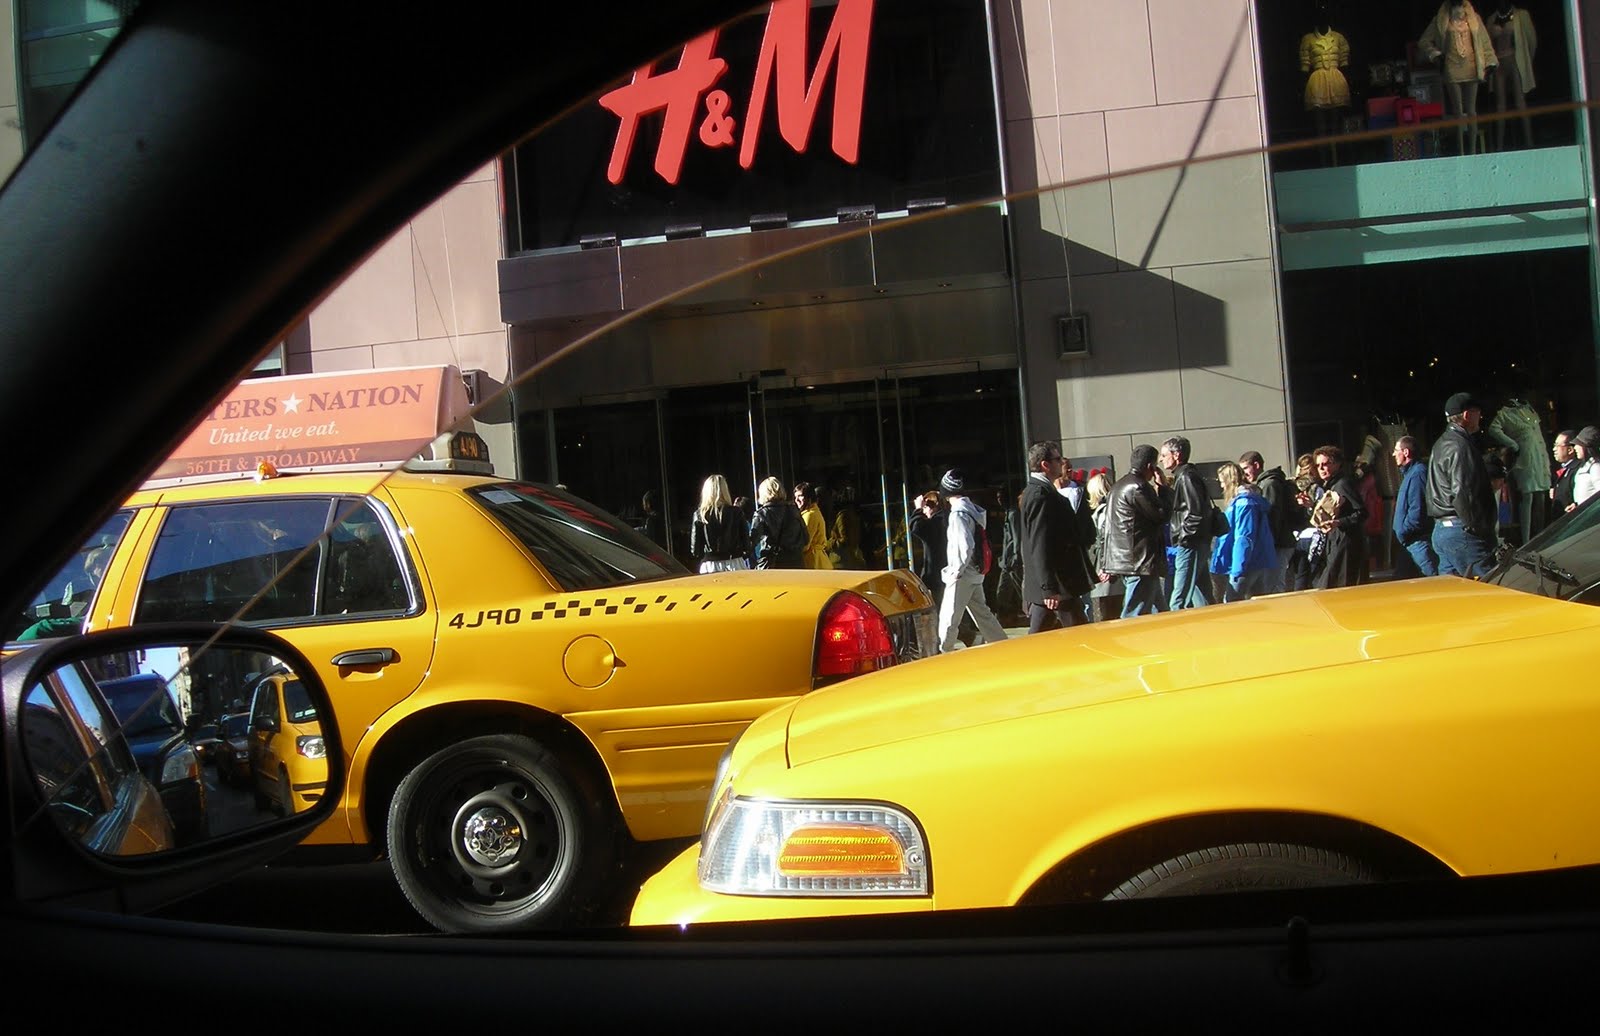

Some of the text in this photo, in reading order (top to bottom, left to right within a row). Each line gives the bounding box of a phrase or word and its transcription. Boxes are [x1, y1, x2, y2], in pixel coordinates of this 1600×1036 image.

[599, 0, 876, 185] H&M
[306, 384, 424, 412] NATION
[209, 420, 340, 445] United we eat.
[186, 447, 360, 475] 56TH & BROADWAY
[448, 607, 522, 630] 4J90
